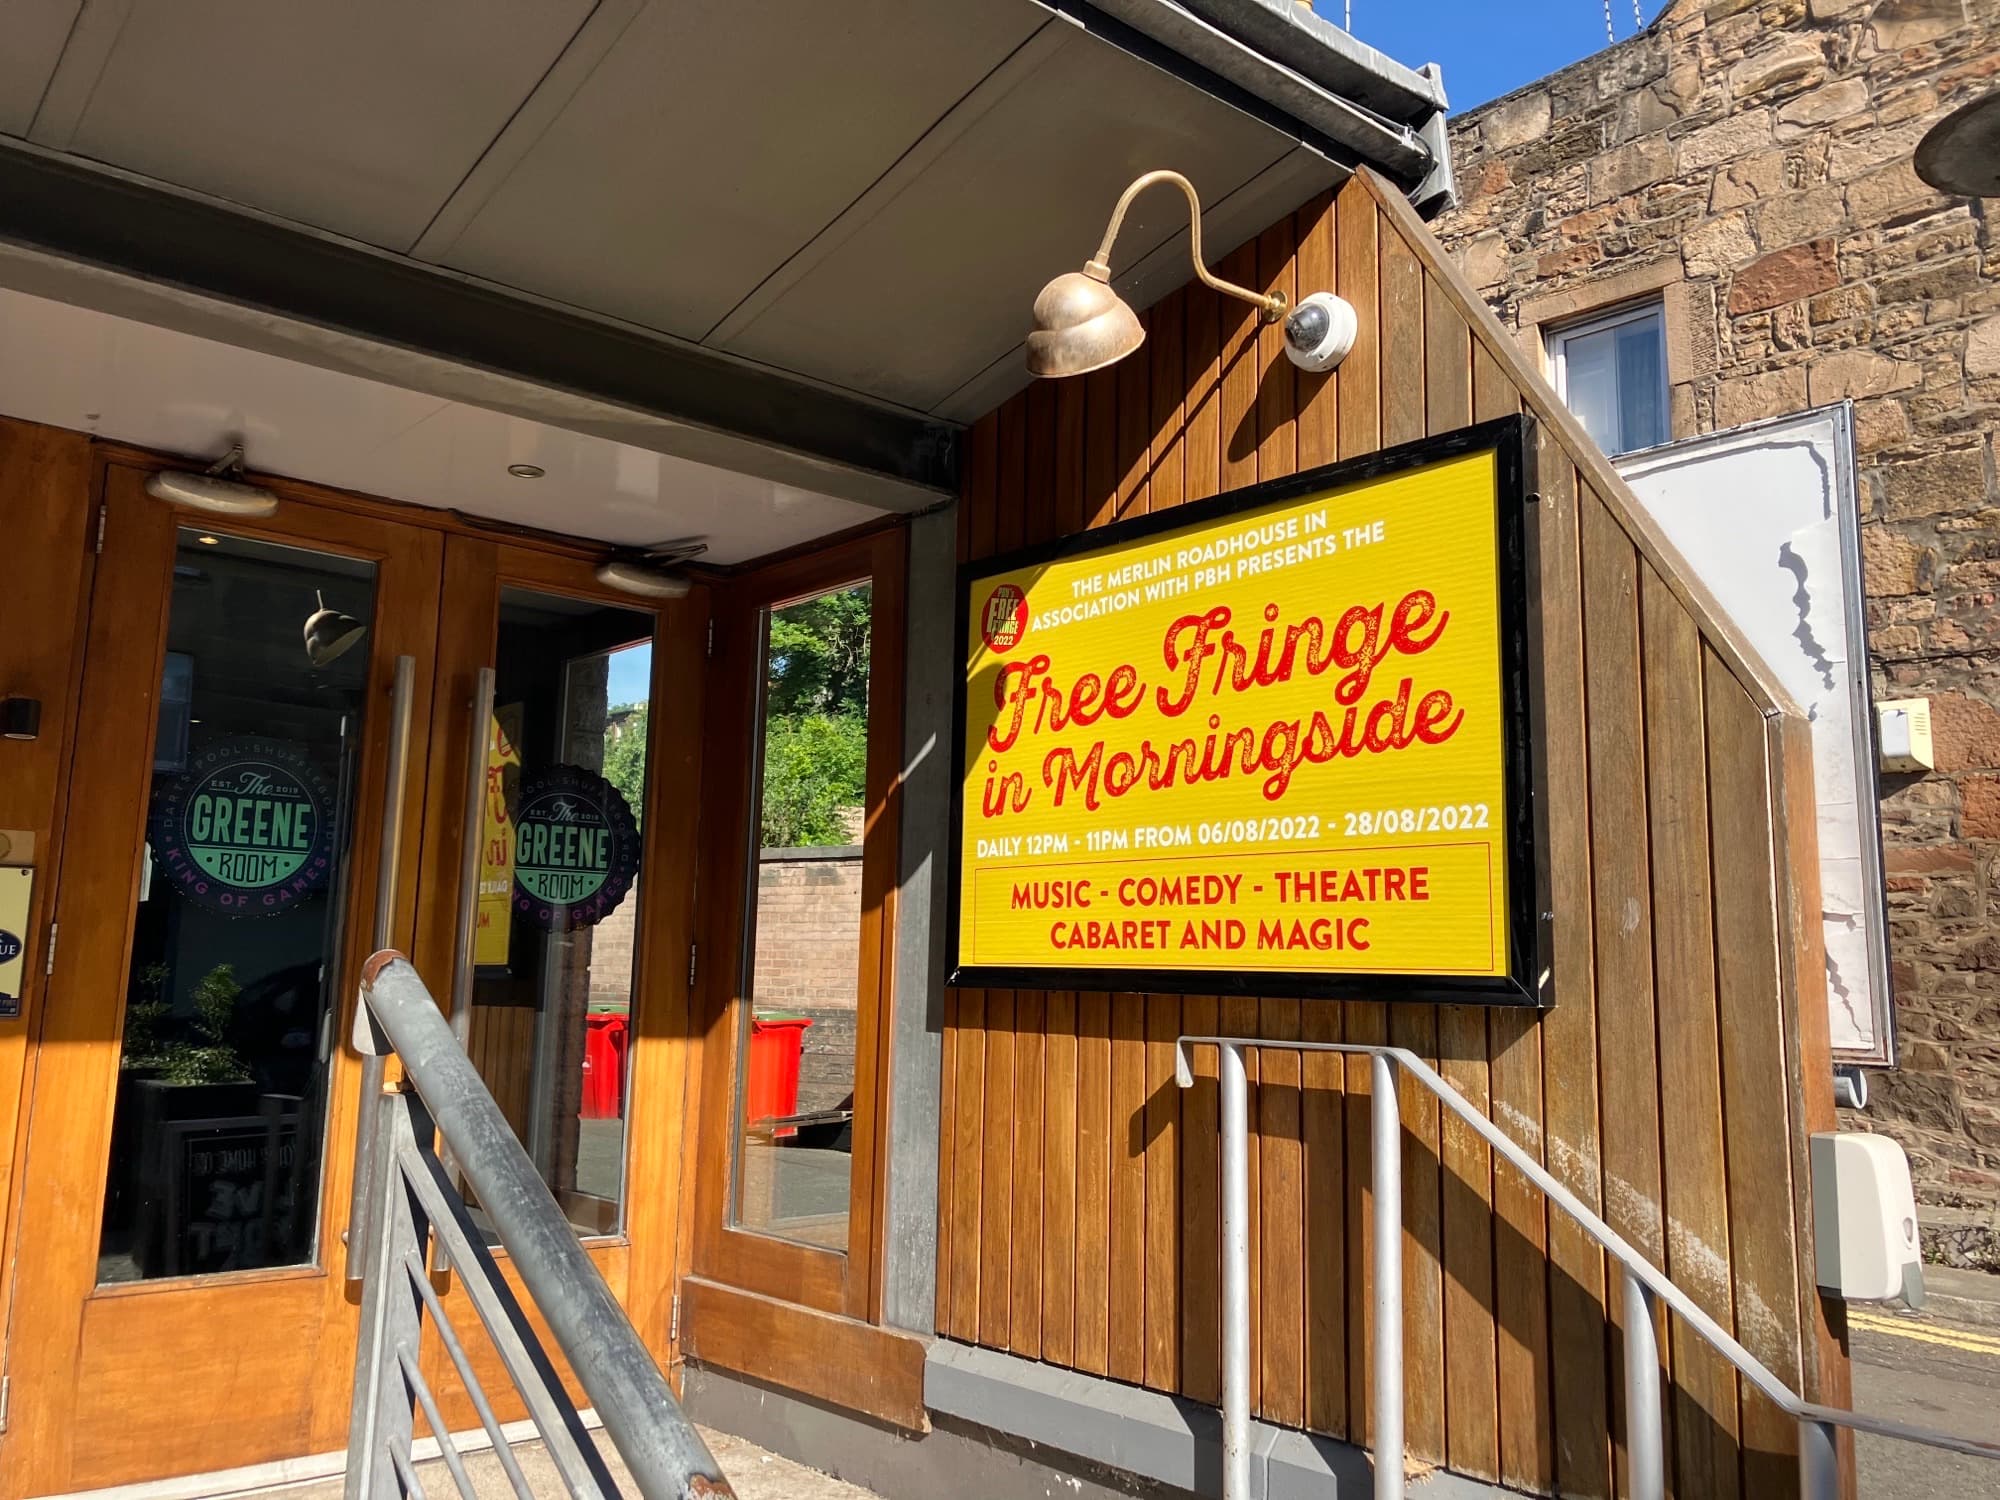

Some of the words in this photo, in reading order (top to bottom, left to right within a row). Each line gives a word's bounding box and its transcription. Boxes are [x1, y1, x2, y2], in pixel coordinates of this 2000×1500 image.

[1031, 588, 1140, 632] ASSOCIATION
[1145, 574, 1189, 602] WITH
[1194, 563, 1231, 590] PBH
[1237, 534, 1337, 579] PRESENTS
[1342, 520, 1385, 550] THE
[1072, 574, 1103, 598] THE
[1107, 555, 1172, 588] MERLIN
[1177, 517, 1298, 569] ROADHOUSE
[1305, 509, 1327, 534] IN
[994, 635, 1014, 646] 2022
[987, 654, 1147, 753] Free
[1156, 589, 1450, 706] Fringe
[982, 760, 1033, 818] in
[1042, 677, 1466, 812] Morningside
[235, 771, 272, 796] The
[191, 794, 312, 848] GREENE
[548, 801, 580, 823] The
[977, 835, 1022, 859] DAILY
[1026, 833, 1069, 856] 12PM
[1086, 828, 1129, 851] 11PM
[1134, 824, 1192, 849] FROM
[1198, 815, 1320, 845] 06/08/2022
[1344, 803, 1490, 836] 28/08/2022
[218, 852, 279, 883] ROOM
[516, 821, 609, 868] GREENE
[167, 848, 209, 895] KING
[220, 893, 249, 907] OF
[262, 856, 327, 906] GAMES
[537, 874, 585, 899] ROOM
[1011, 879, 1092, 909] MUSIC
[1118, 874, 1243, 907] COMEDY
[1274, 866, 1430, 903] THEATRE
[1050, 920, 1171, 949] CABARET
[1179, 919, 1246, 950] AND
[1257, 917, 1371, 951] MAGIC
